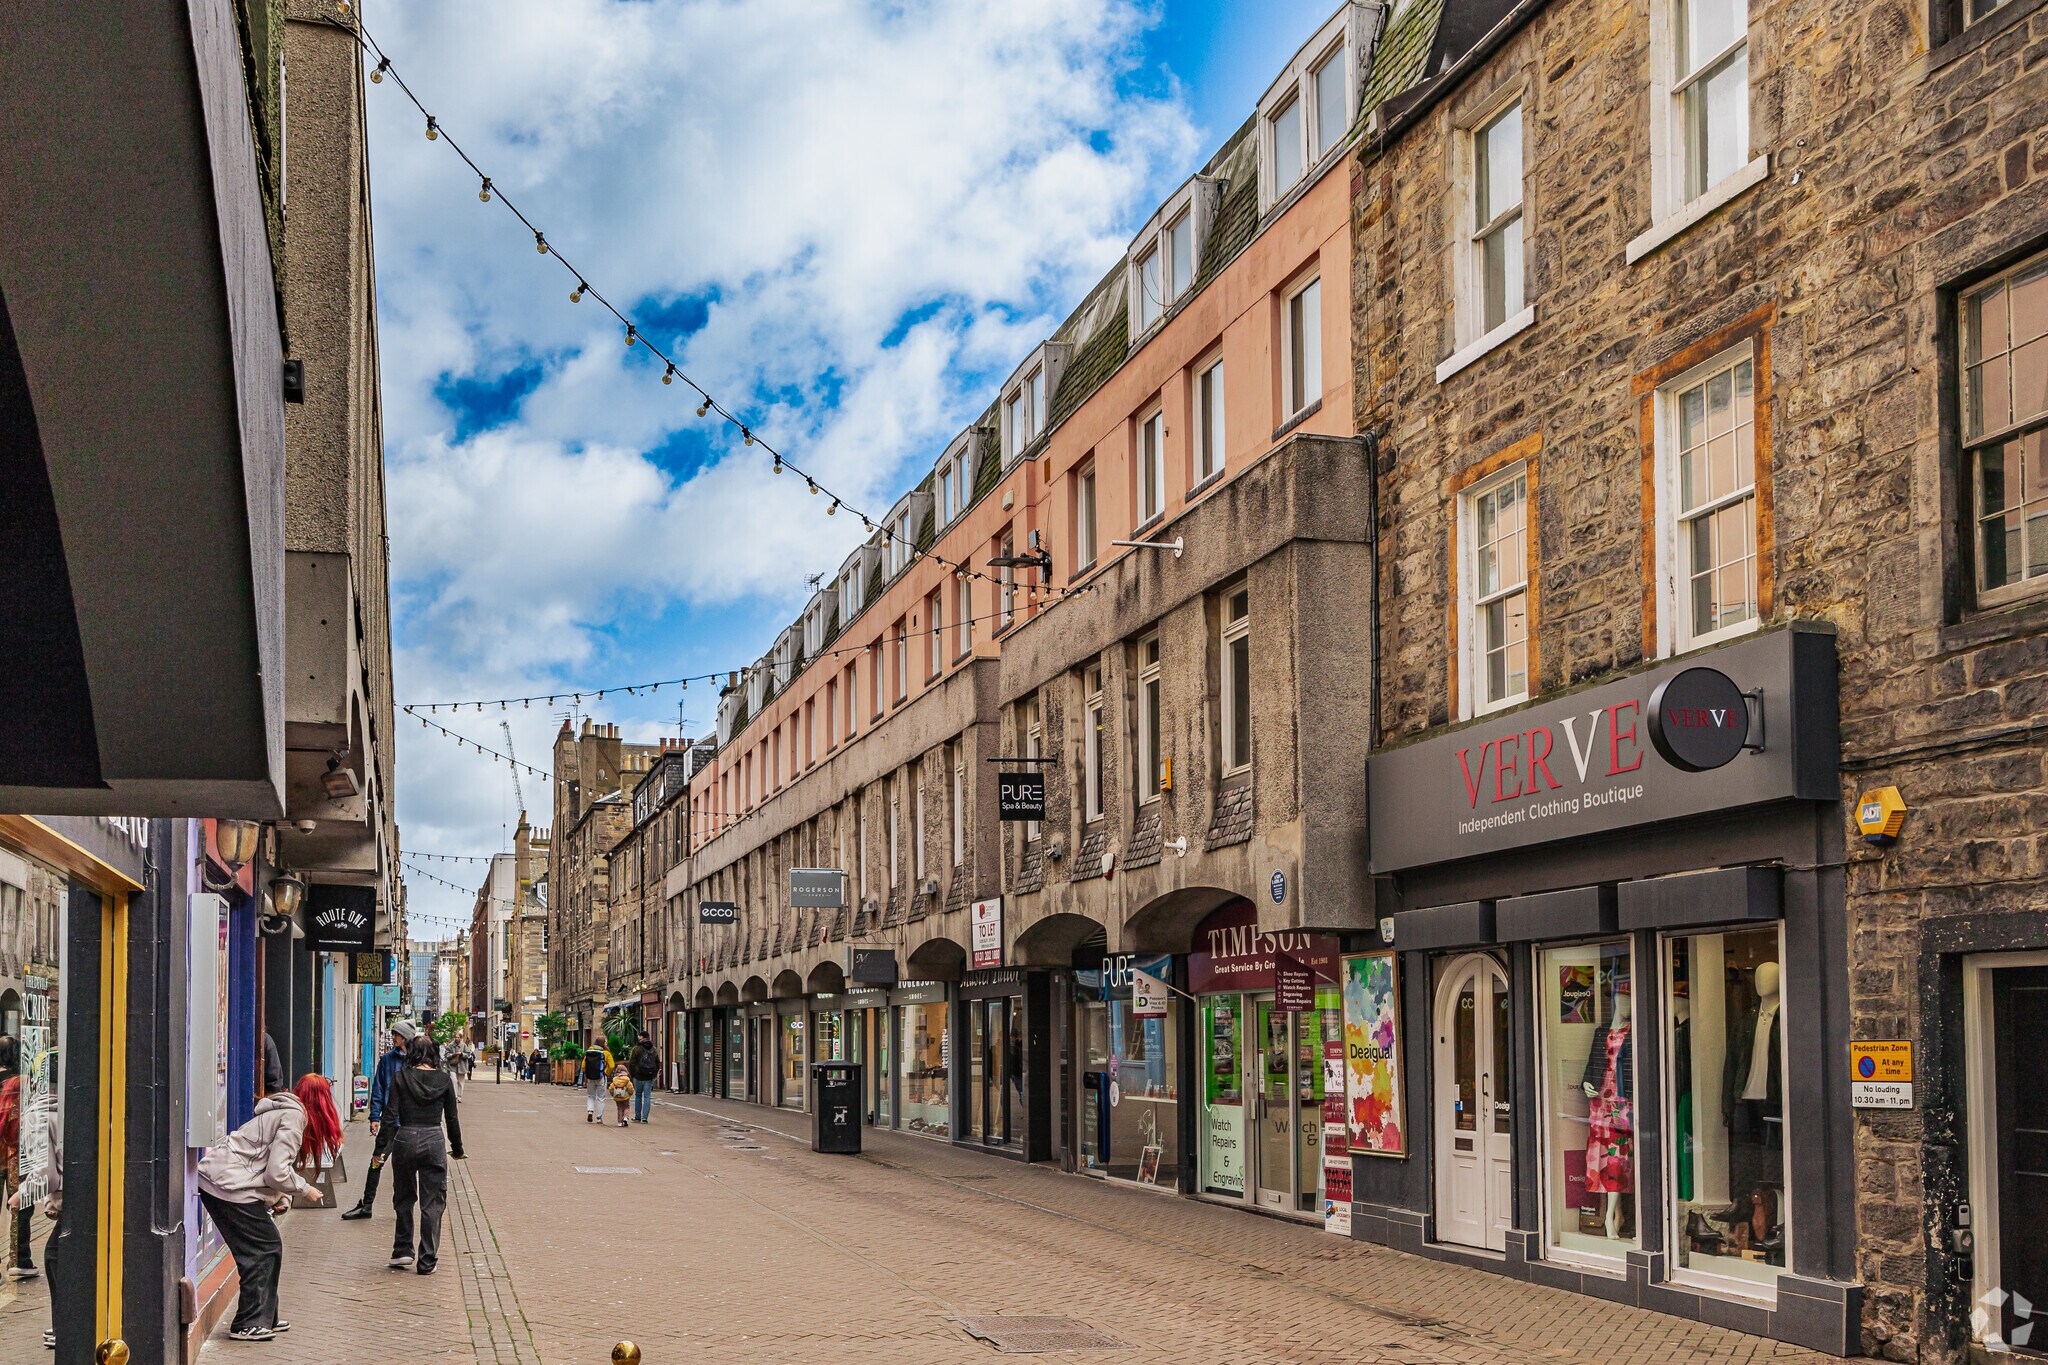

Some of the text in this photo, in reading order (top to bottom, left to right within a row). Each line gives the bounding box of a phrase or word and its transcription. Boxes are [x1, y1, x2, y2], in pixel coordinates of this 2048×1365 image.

[1667, 709, 1740, 728] VERVE
[1455, 699, 1644, 809] VERVE
[1001, 785, 1043, 801] PURE
[1002, 802, 1043, 811] Spa & Beauty
[1459, 784, 1643, 835] Independent Clothing Boutique
[1862, 806, 1882, 820] ADT
[316, 908, 367, 928] ROUTE ONE
[702, 908, 733, 917] ecco
[979, 923, 996, 938] TO LET
[1207, 923, 1311, 959] TIMPSON
[1215, 965, 1230, 974] Great
[1231, 963, 1253, 973] Service
[1255, 962, 1263, 972] By
[22, 993, 50, 1020] SCRIBE
[1350, 1043, 1393, 1062] Desigual
[1891, 1044, 1908, 1052] Zone
[1875, 1086, 1900, 1094] loading
[1854, 1096, 1874, 1104] 10.30
[1899, 1098, 1910, 1106] pm
[1212, 1118, 1232, 1132] Watch
[1213, 1135, 1237, 1149] Repairs
[1307, 1134, 1318, 1146] &
[1223, 1156, 1230, 1168] &
